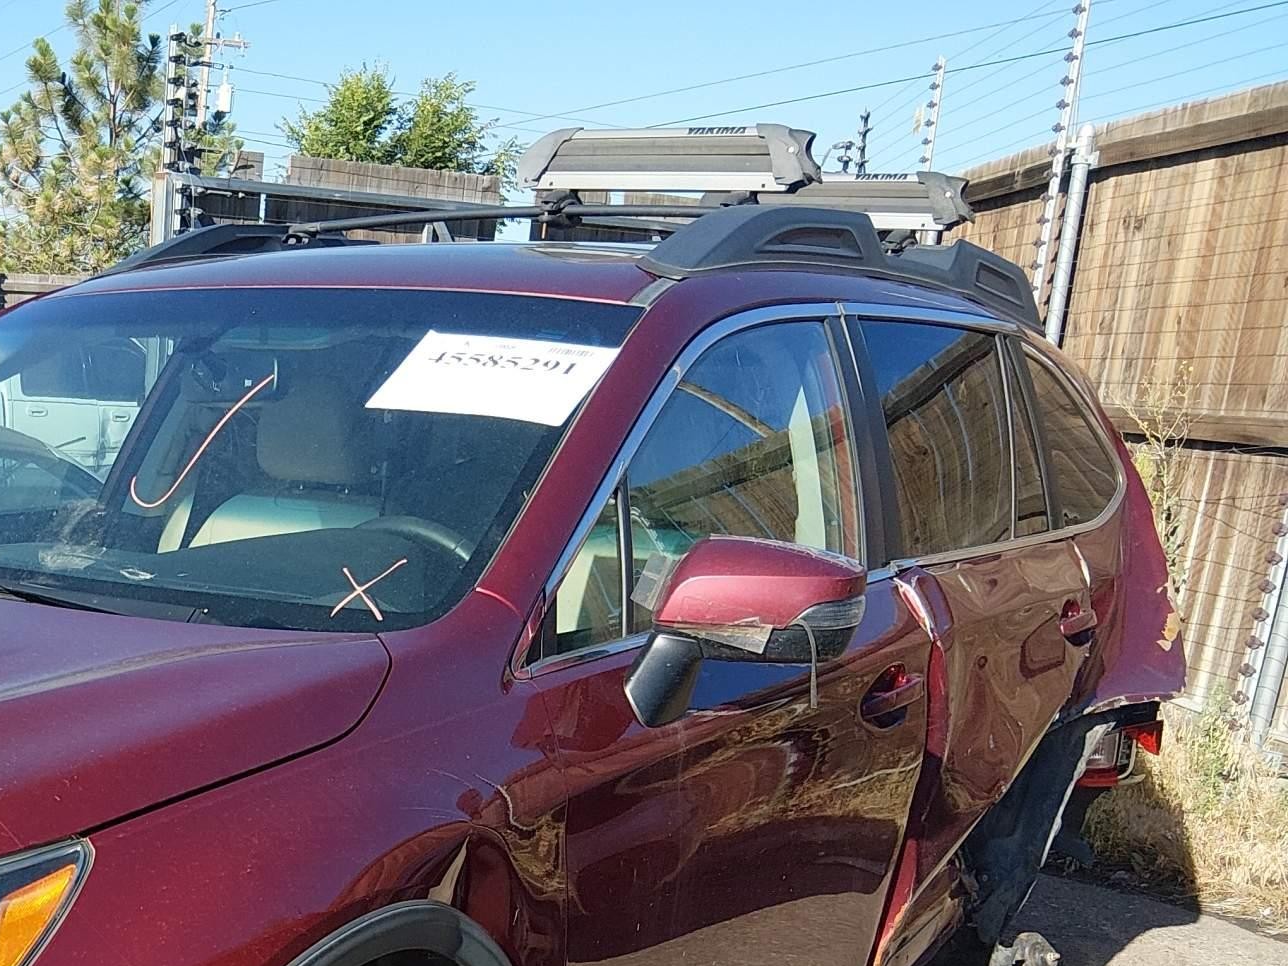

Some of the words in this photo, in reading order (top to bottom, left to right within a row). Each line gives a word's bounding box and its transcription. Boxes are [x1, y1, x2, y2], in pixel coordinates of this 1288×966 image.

[688, 126, 747, 135] YAKIMA
[855, 173, 909, 181] YAKIMA
[428, 351, 577, 375] 45585291
